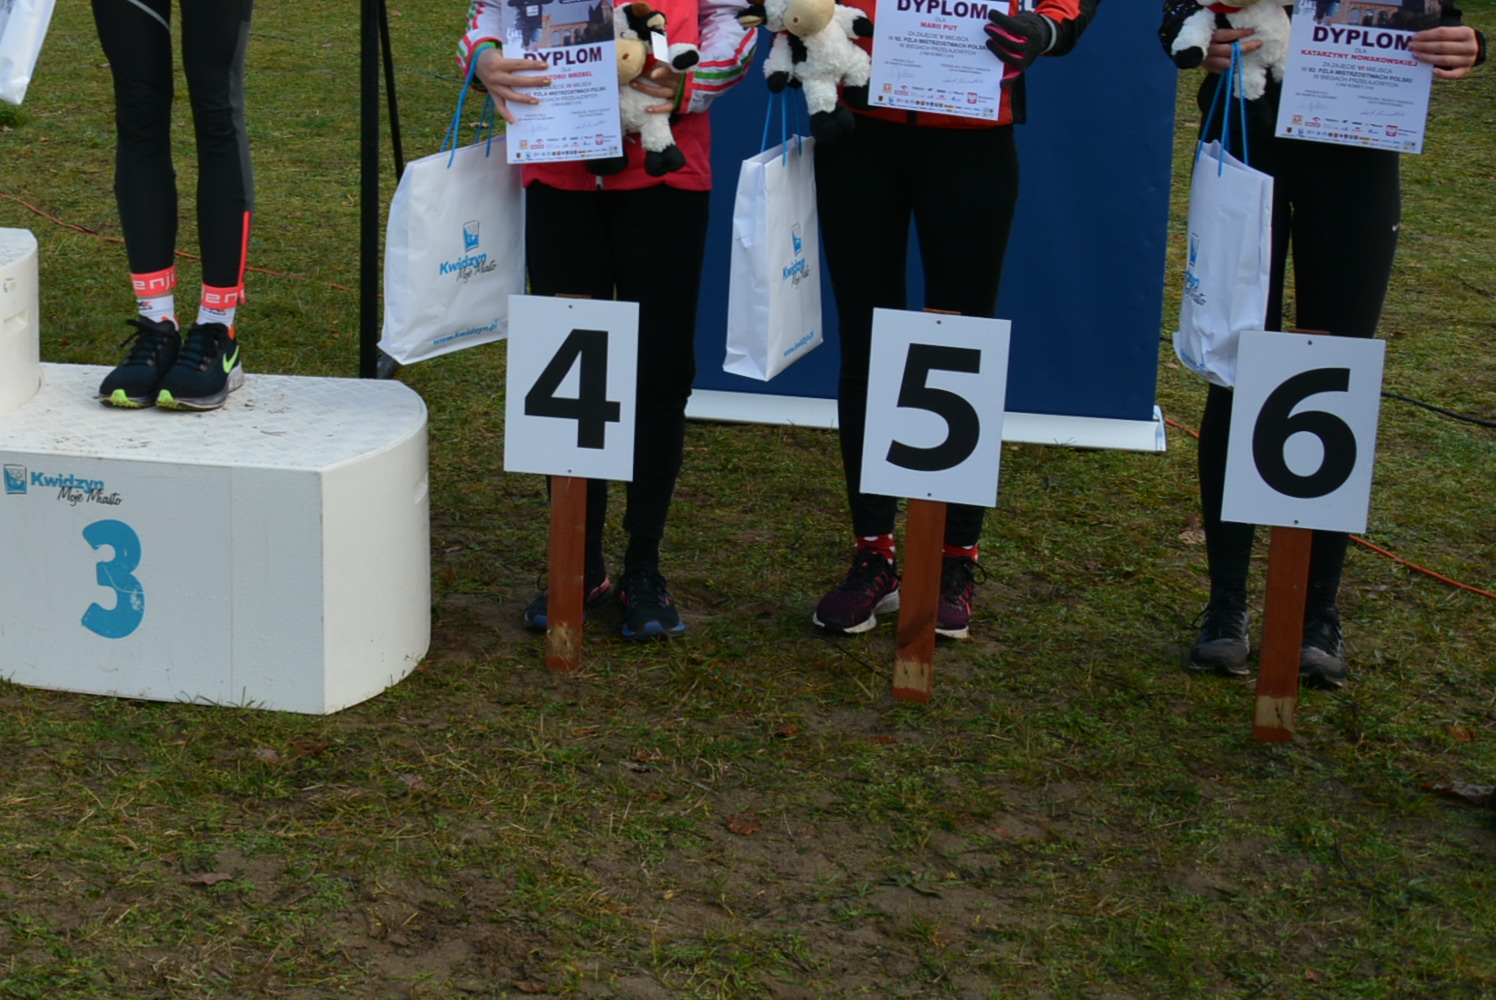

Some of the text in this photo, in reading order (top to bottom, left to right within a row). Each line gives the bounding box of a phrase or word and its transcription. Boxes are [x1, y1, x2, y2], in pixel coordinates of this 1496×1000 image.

[1313, 26, 1414, 51] DYPLOM
[439, 253, 488, 275] Kwidzyn
[524, 328, 621, 450] 4
[885, 343, 982, 472] 5
[1252, 367, 1357, 499] 6
[31, 471, 104, 494] Kwidzyn
[80, 519, 146, 639] 3
